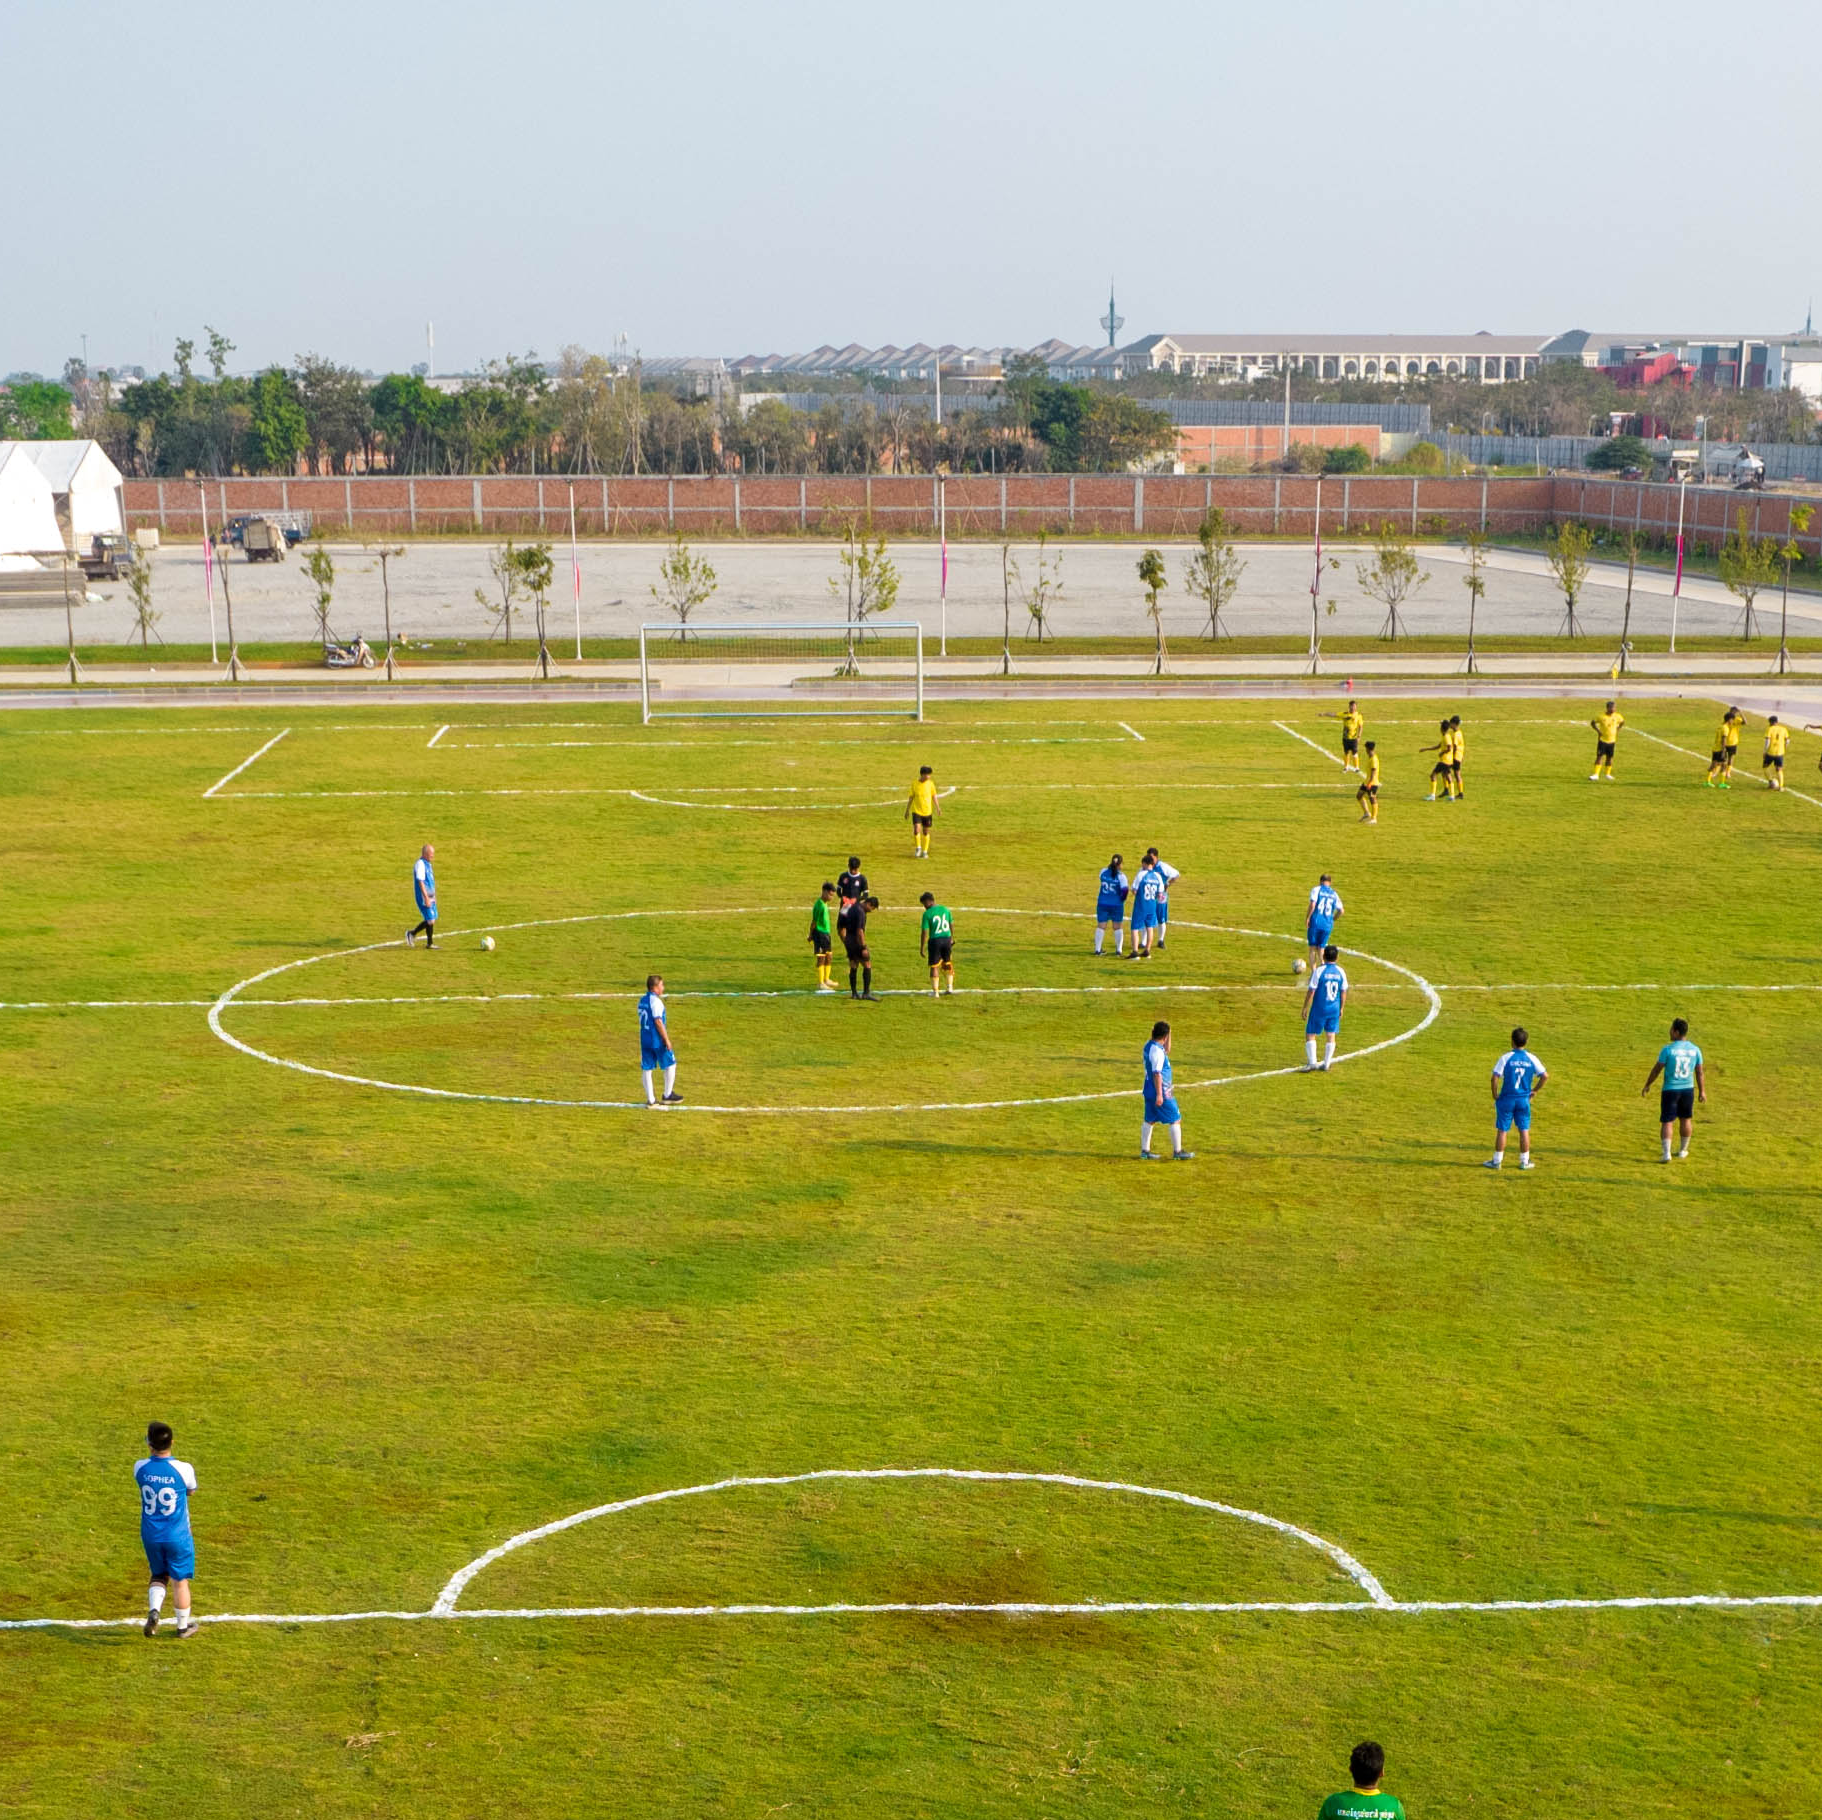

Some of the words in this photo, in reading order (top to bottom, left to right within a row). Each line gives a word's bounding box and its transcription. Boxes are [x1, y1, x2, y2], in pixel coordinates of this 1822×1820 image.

[933, 914, 949, 934] 26
[1325, 980, 1339, 1001] 10
[1675, 1056, 1691, 1078] 13
[1515, 1067, 1525, 1089] 7
[143, 1474, 175, 1484] SOPHEA
[142, 1485, 178, 1517] 99
